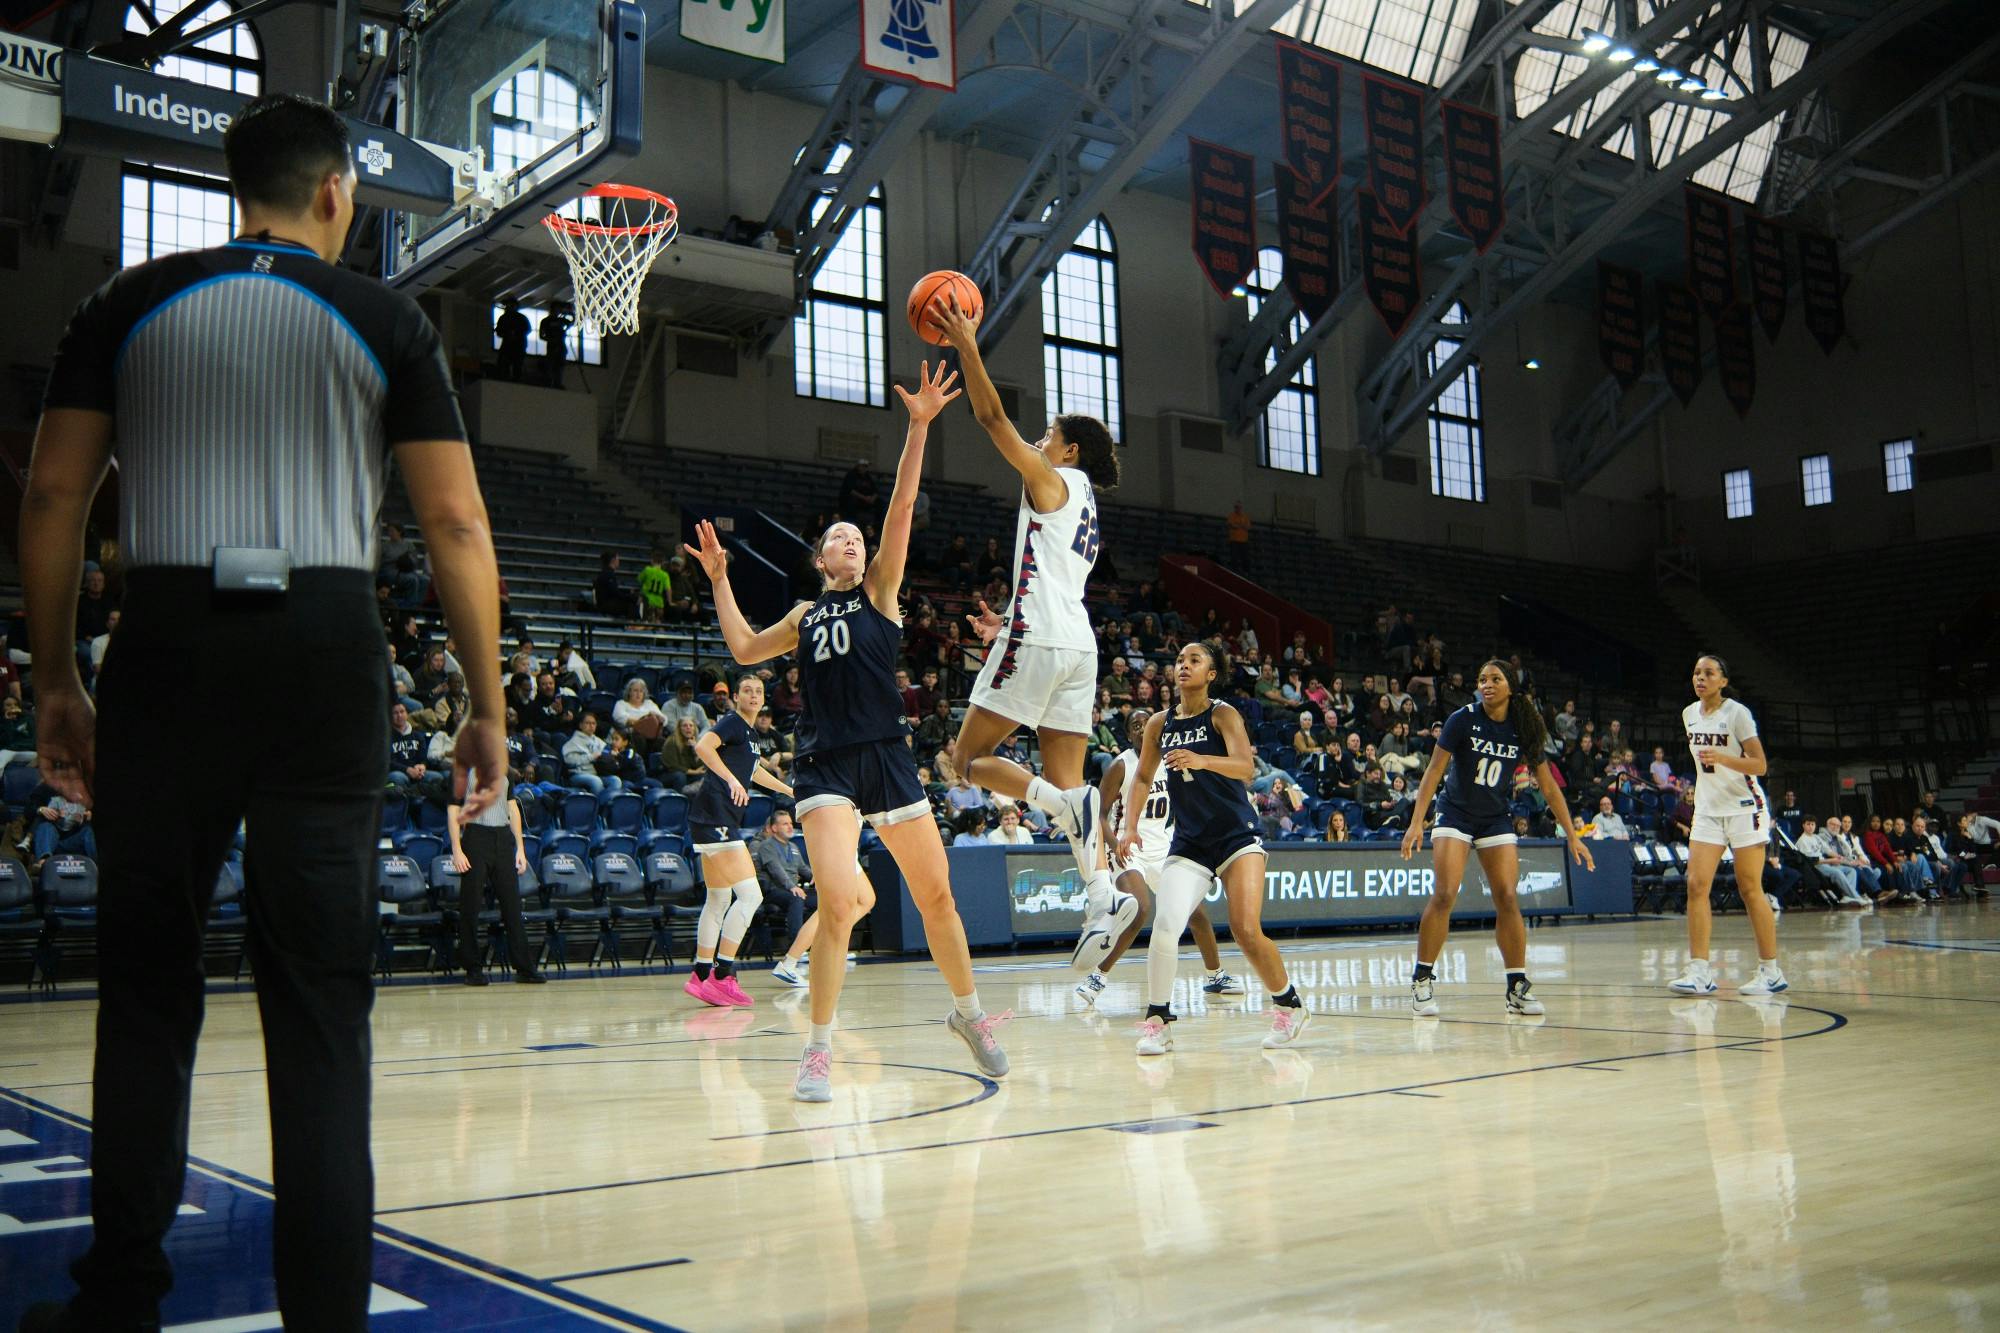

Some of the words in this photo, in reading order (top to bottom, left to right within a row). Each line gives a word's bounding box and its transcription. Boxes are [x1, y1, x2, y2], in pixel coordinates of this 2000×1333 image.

[1070, 506, 1099, 565] 22
[804, 596, 862, 627] YALE
[812, 619, 850, 663] 20
[392, 739, 419, 753] YALE
[1161, 726, 1208, 748] YALE
[1470, 737, 1519, 759] YALE
[1687, 733, 1729, 746] PENN
[1474, 758, 1502, 787] 10
[1146, 797, 1168, 818] 10
[715, 826, 728, 841] Y
[1265, 868, 1358, 900] TRAVEL
[1365, 868, 1462, 898] EXPER
